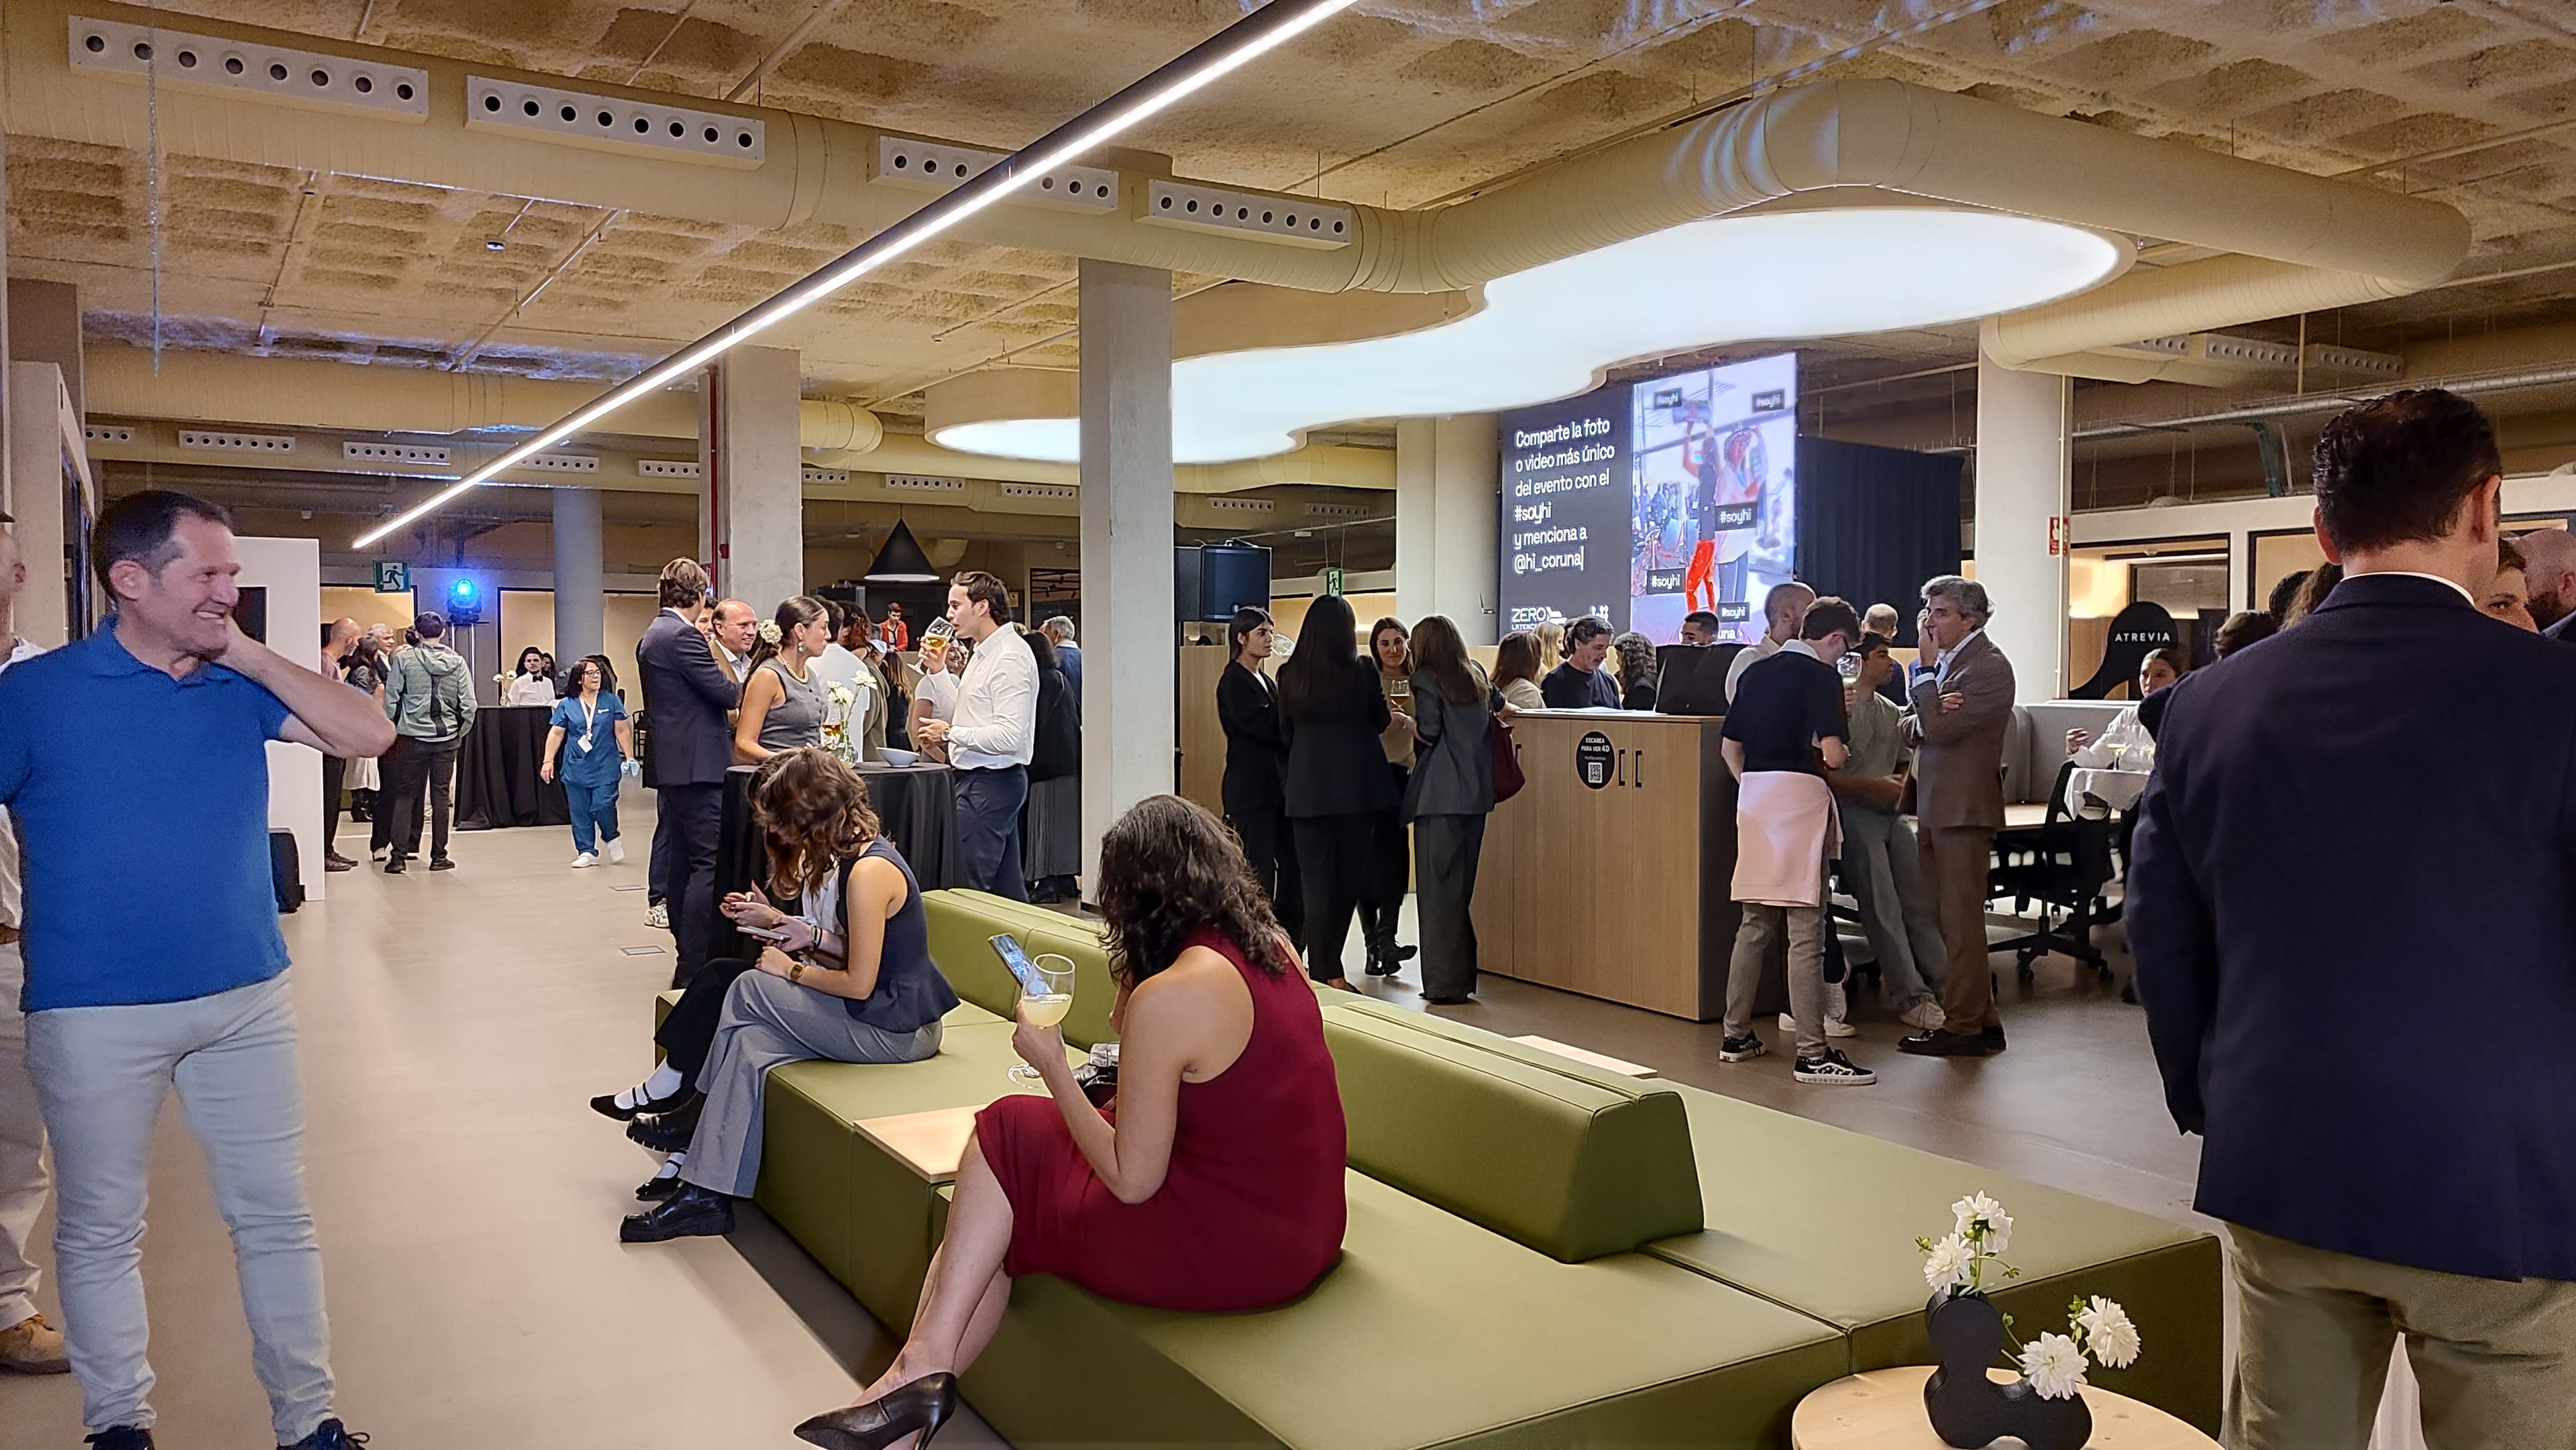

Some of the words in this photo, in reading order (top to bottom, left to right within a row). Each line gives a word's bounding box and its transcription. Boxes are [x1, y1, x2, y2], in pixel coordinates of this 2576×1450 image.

[1756, 394, 1780, 408] #soyhi
[1515, 425, 1570, 448] Comparte
[1572, 421, 1582, 438] la
[1584, 417, 1610, 437] foto
[1515, 459, 1523, 473] o
[1556, 447, 1580, 467] más
[1582, 443, 1615, 463] único
[1515, 479, 1532, 497] del
[1534, 476, 1573, 494] evento
[1574, 474, 1597, 489] con
[1599, 467, 1610, 486] el
[1515, 501, 1552, 524] #soyhi
[1720, 508, 1752, 524] #soyhi
[1513, 534, 1522, 551] y
[1523, 526, 1578, 546] menciona
[1579, 526, 1587, 541] a
[1651, 574, 1680, 590] #soyhi
[1512, 606, 1547, 622] ZERO
[1721, 607, 1746, 619] #soyhi
[2114, 632, 2171, 643] ATREVIA
